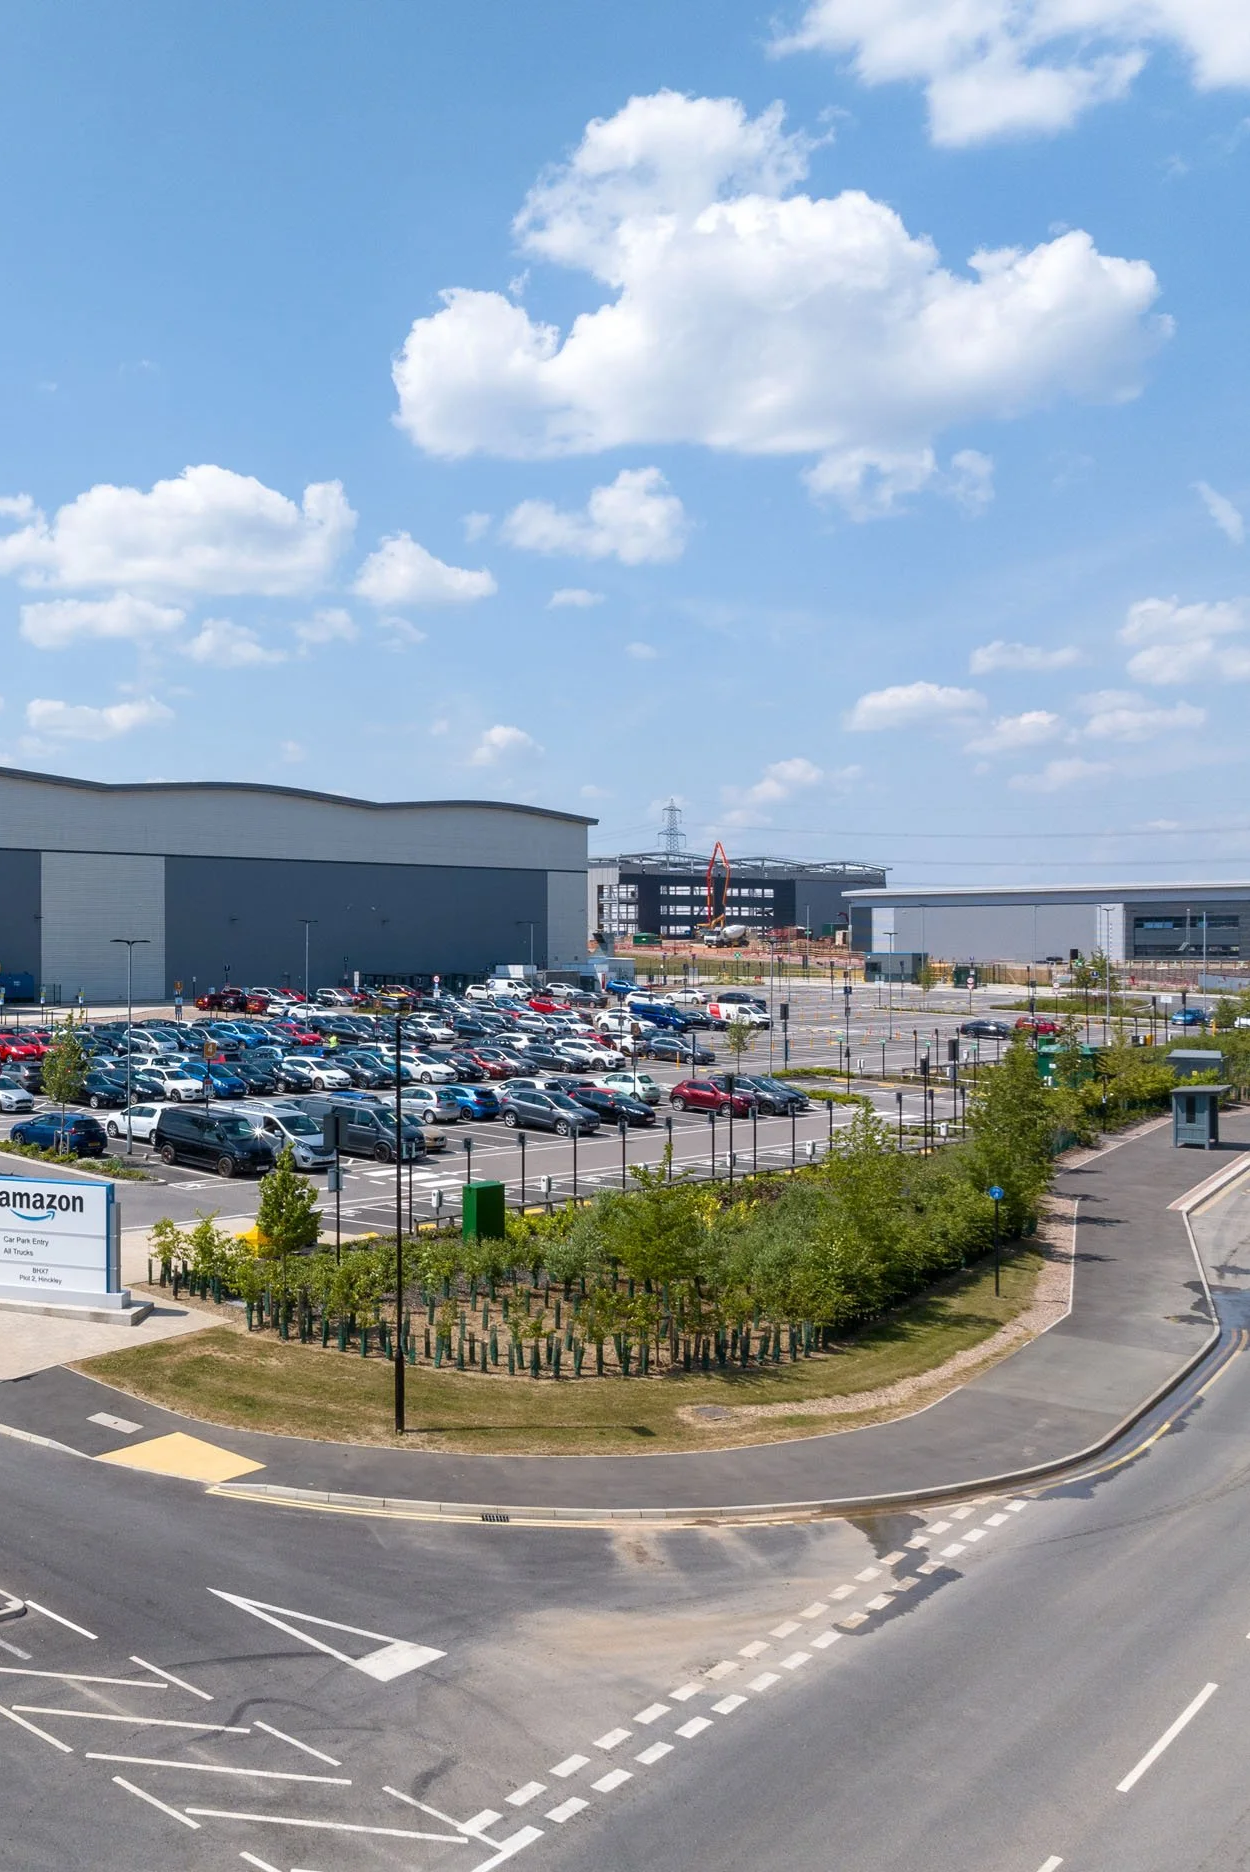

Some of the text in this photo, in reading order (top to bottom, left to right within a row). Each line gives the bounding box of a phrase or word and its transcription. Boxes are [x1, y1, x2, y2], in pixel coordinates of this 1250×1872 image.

[3, 1235, 49, 1247] Car Park Entry
[13, 1248, 34, 1256] Trucks
[38, 1276, 63, 1285] Hinckley
